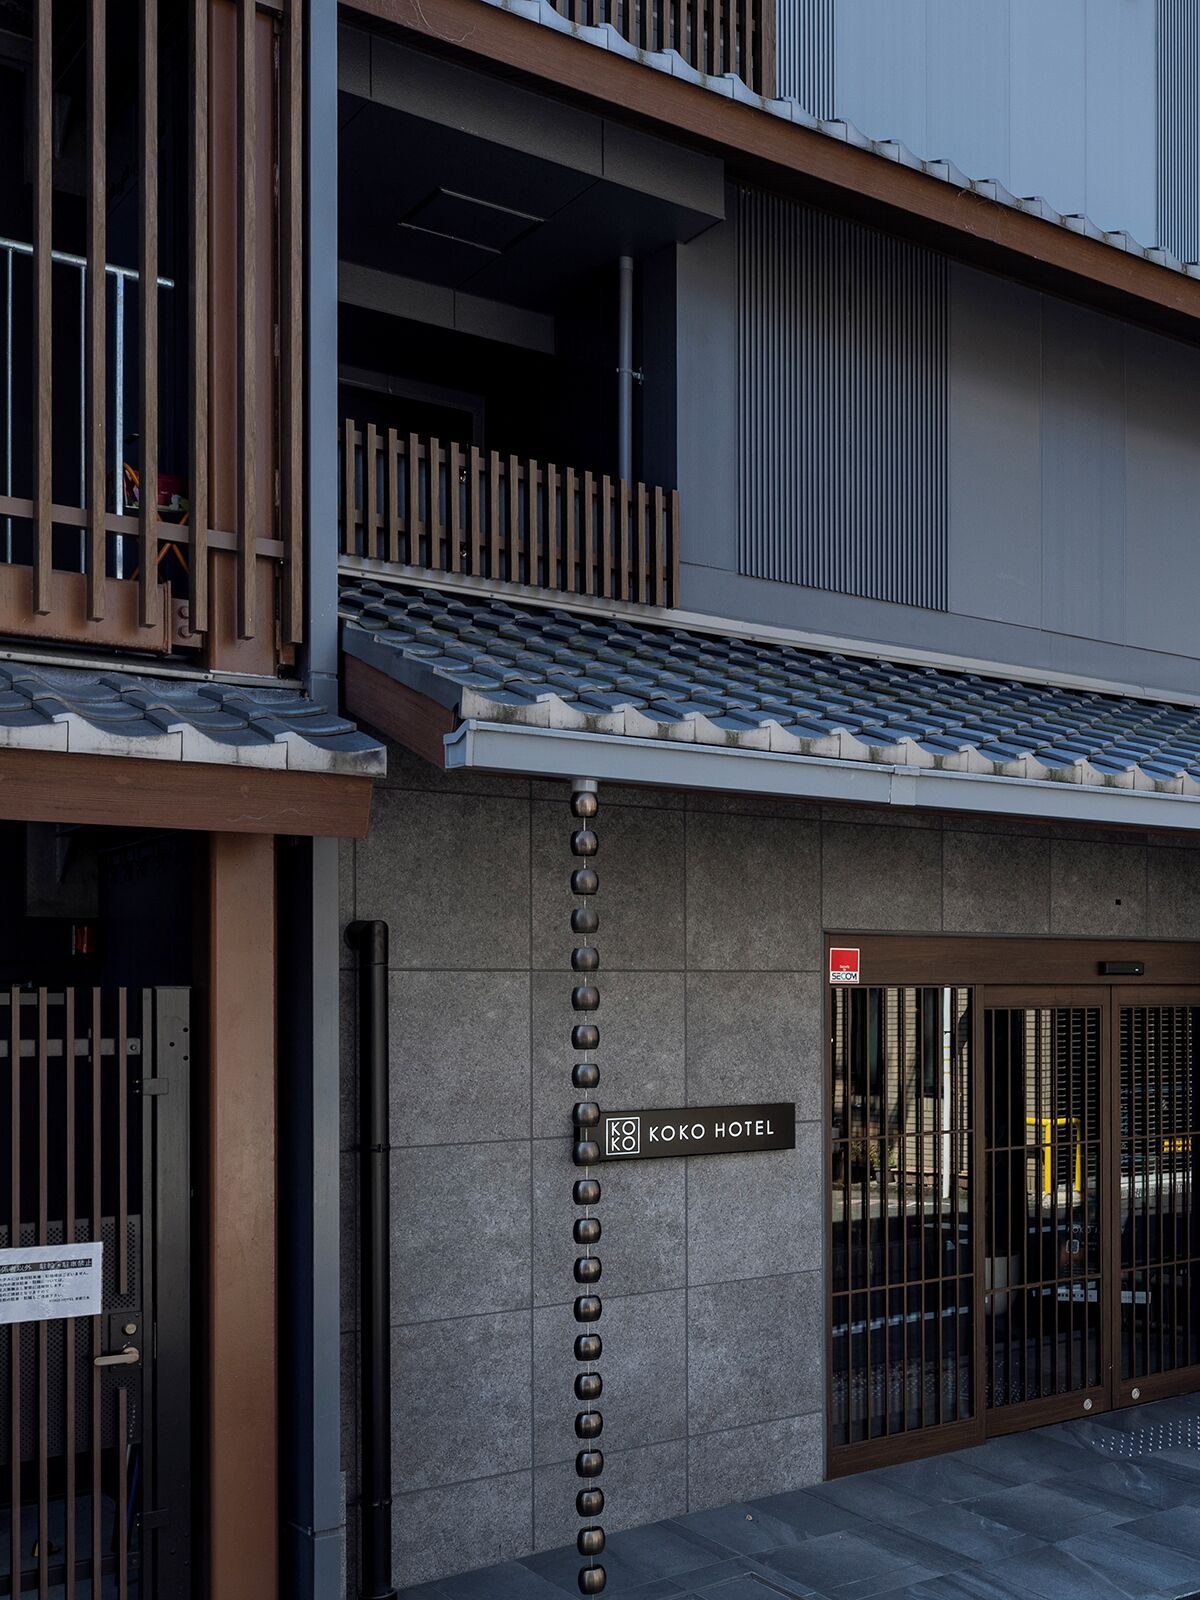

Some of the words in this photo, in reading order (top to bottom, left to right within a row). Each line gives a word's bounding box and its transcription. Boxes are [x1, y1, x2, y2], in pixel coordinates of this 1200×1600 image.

[831, 972, 858, 980] SECOM
[610, 1120, 636, 1136] KO
[649, 1123, 705, 1142] KOKO
[714, 1119, 774, 1138] HOTEL
[610, 1135, 636, 1152] KO
